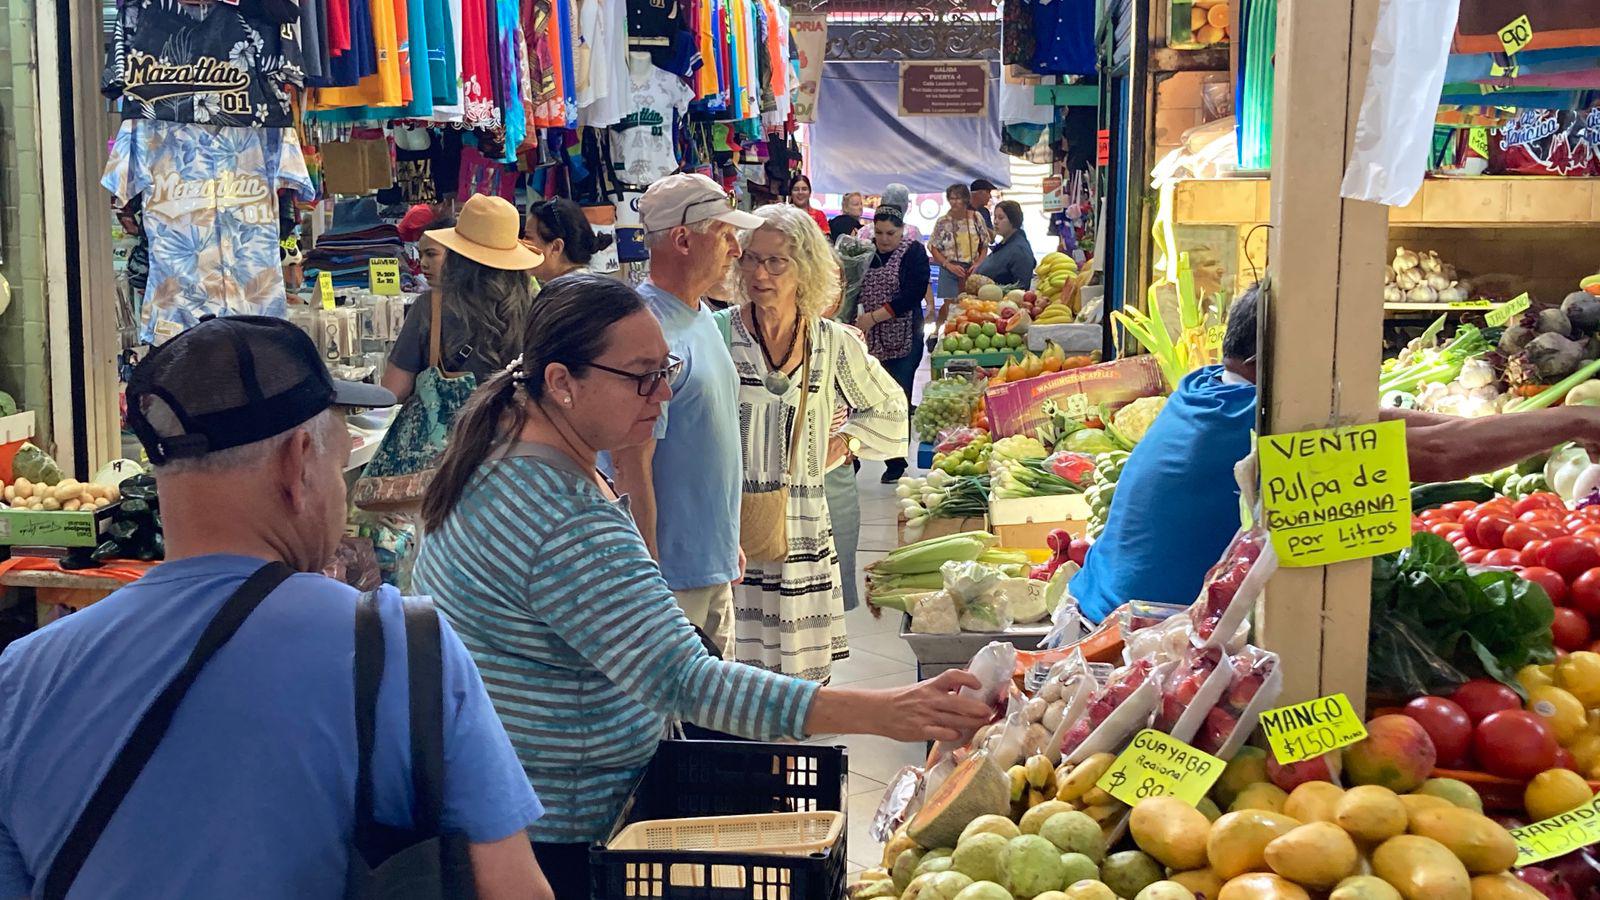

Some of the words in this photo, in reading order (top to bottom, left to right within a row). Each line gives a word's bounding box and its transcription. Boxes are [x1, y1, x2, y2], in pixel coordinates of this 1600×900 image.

[790, 20, 824, 32] ORIA
[125, 54, 249, 86] Mazatlán
[221, 92, 252, 115] 01
[651, 126, 663, 136] 01
[152, 171, 268, 202] Mazatlán
[243, 204, 273, 223] 01
[1037, 373, 1086, 392] WASHINGTON
[1086, 371, 1115, 382] APPLES
[1270, 429, 1377, 460] VENTA
[1268, 471, 1341, 506] Pulpa
[1353, 464, 1387, 487] de
[1267, 493, 1395, 530] GUANABANA
[1263, 697, 1343, 737] MANGO
[1134, 731, 1211, 776] GUAYABA
[1136, 755, 1188, 782] Regional
